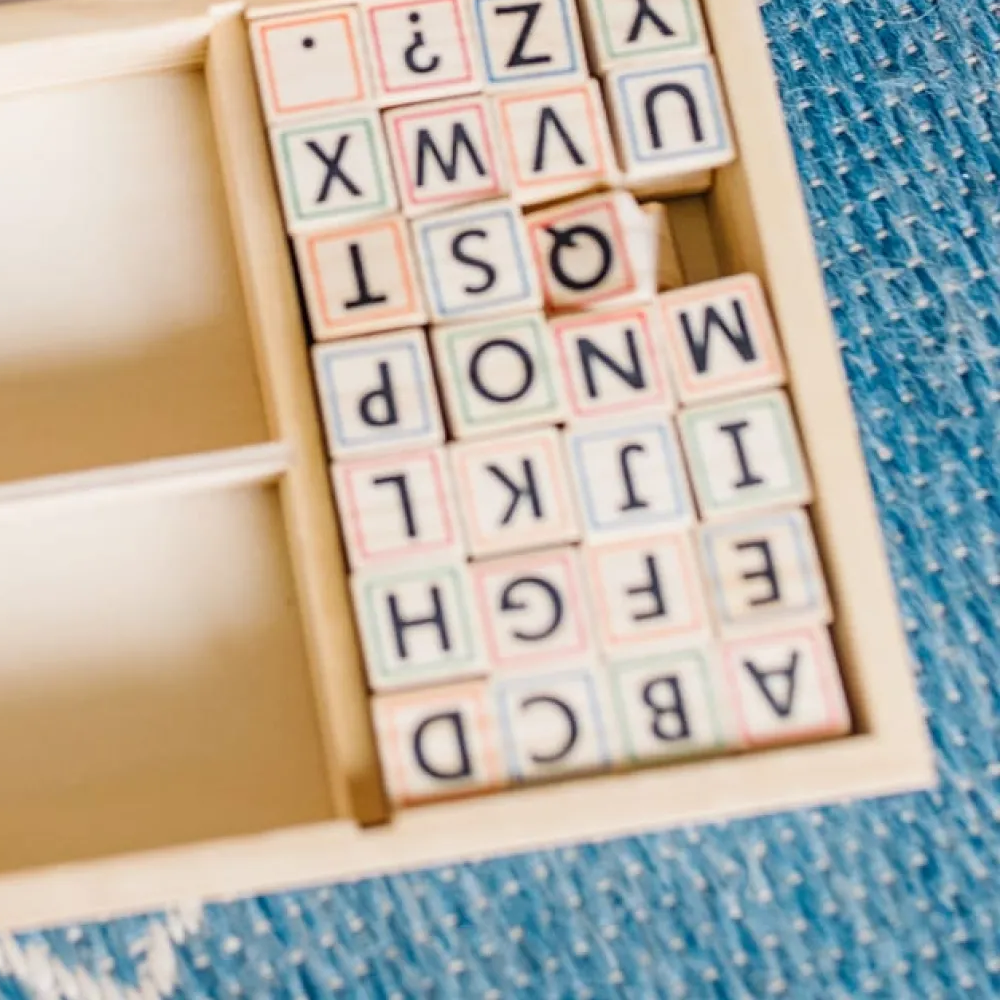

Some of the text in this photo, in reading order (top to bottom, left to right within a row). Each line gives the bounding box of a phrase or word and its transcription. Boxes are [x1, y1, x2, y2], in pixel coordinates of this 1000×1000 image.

[404, 12, 440, 74] ?
[495, 2, 552, 68] Z
[306, 83, 703, 203] U V W X
[344, 224, 613, 310] Q S T
[359, 300, 756, 427] M N O P
[374, 474, 416, 537] L
[488, 459, 542, 524] K
[620, 444, 646, 511] J
[388, 540, 780, 658] E F G H
[413, 654, 797, 780] A B C D
